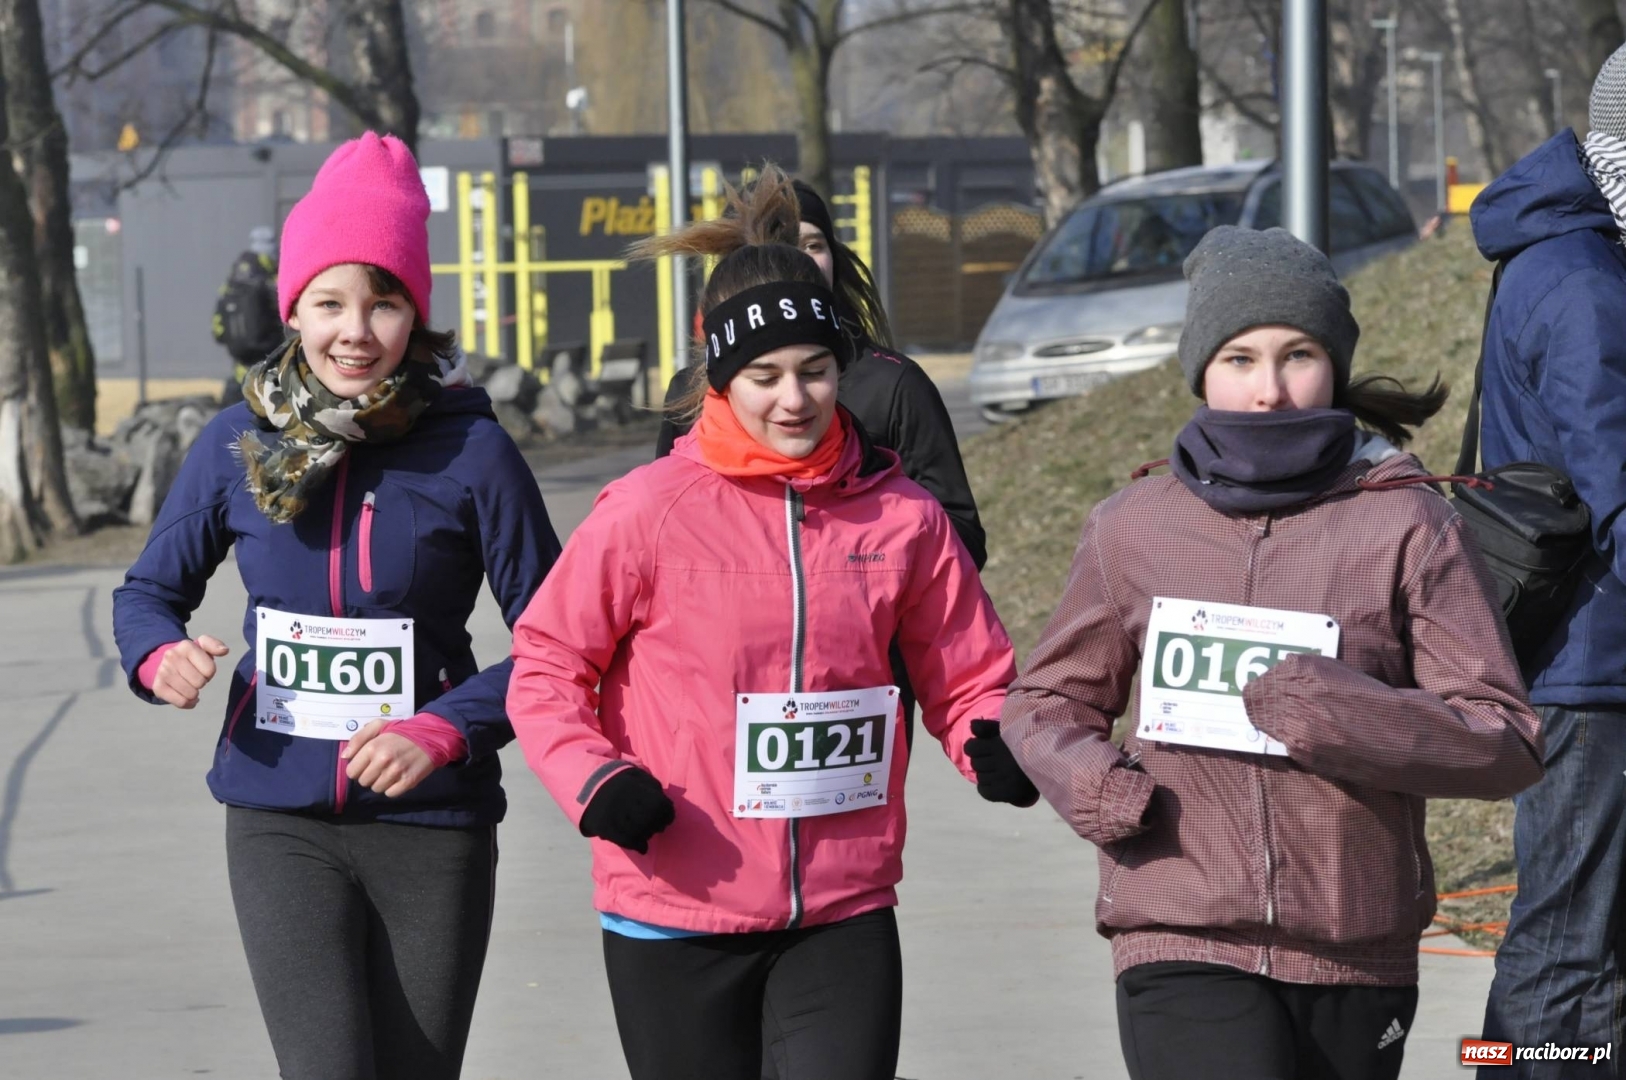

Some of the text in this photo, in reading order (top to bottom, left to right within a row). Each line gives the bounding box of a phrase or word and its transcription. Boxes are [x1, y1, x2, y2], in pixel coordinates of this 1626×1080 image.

[578, 195, 661, 237] Plaż
[704, 297, 840, 371] OURSEL
[304, 624, 367, 637] TROPEMWILCZYM
[1210, 613, 1285, 631] TROPEMWILCZYM
[271, 644, 396, 693] 0160
[1160, 637, 1303, 692] 016
[800, 699, 860, 712] TROPEMWILCZYM
[756, 720, 878, 770] 0121
